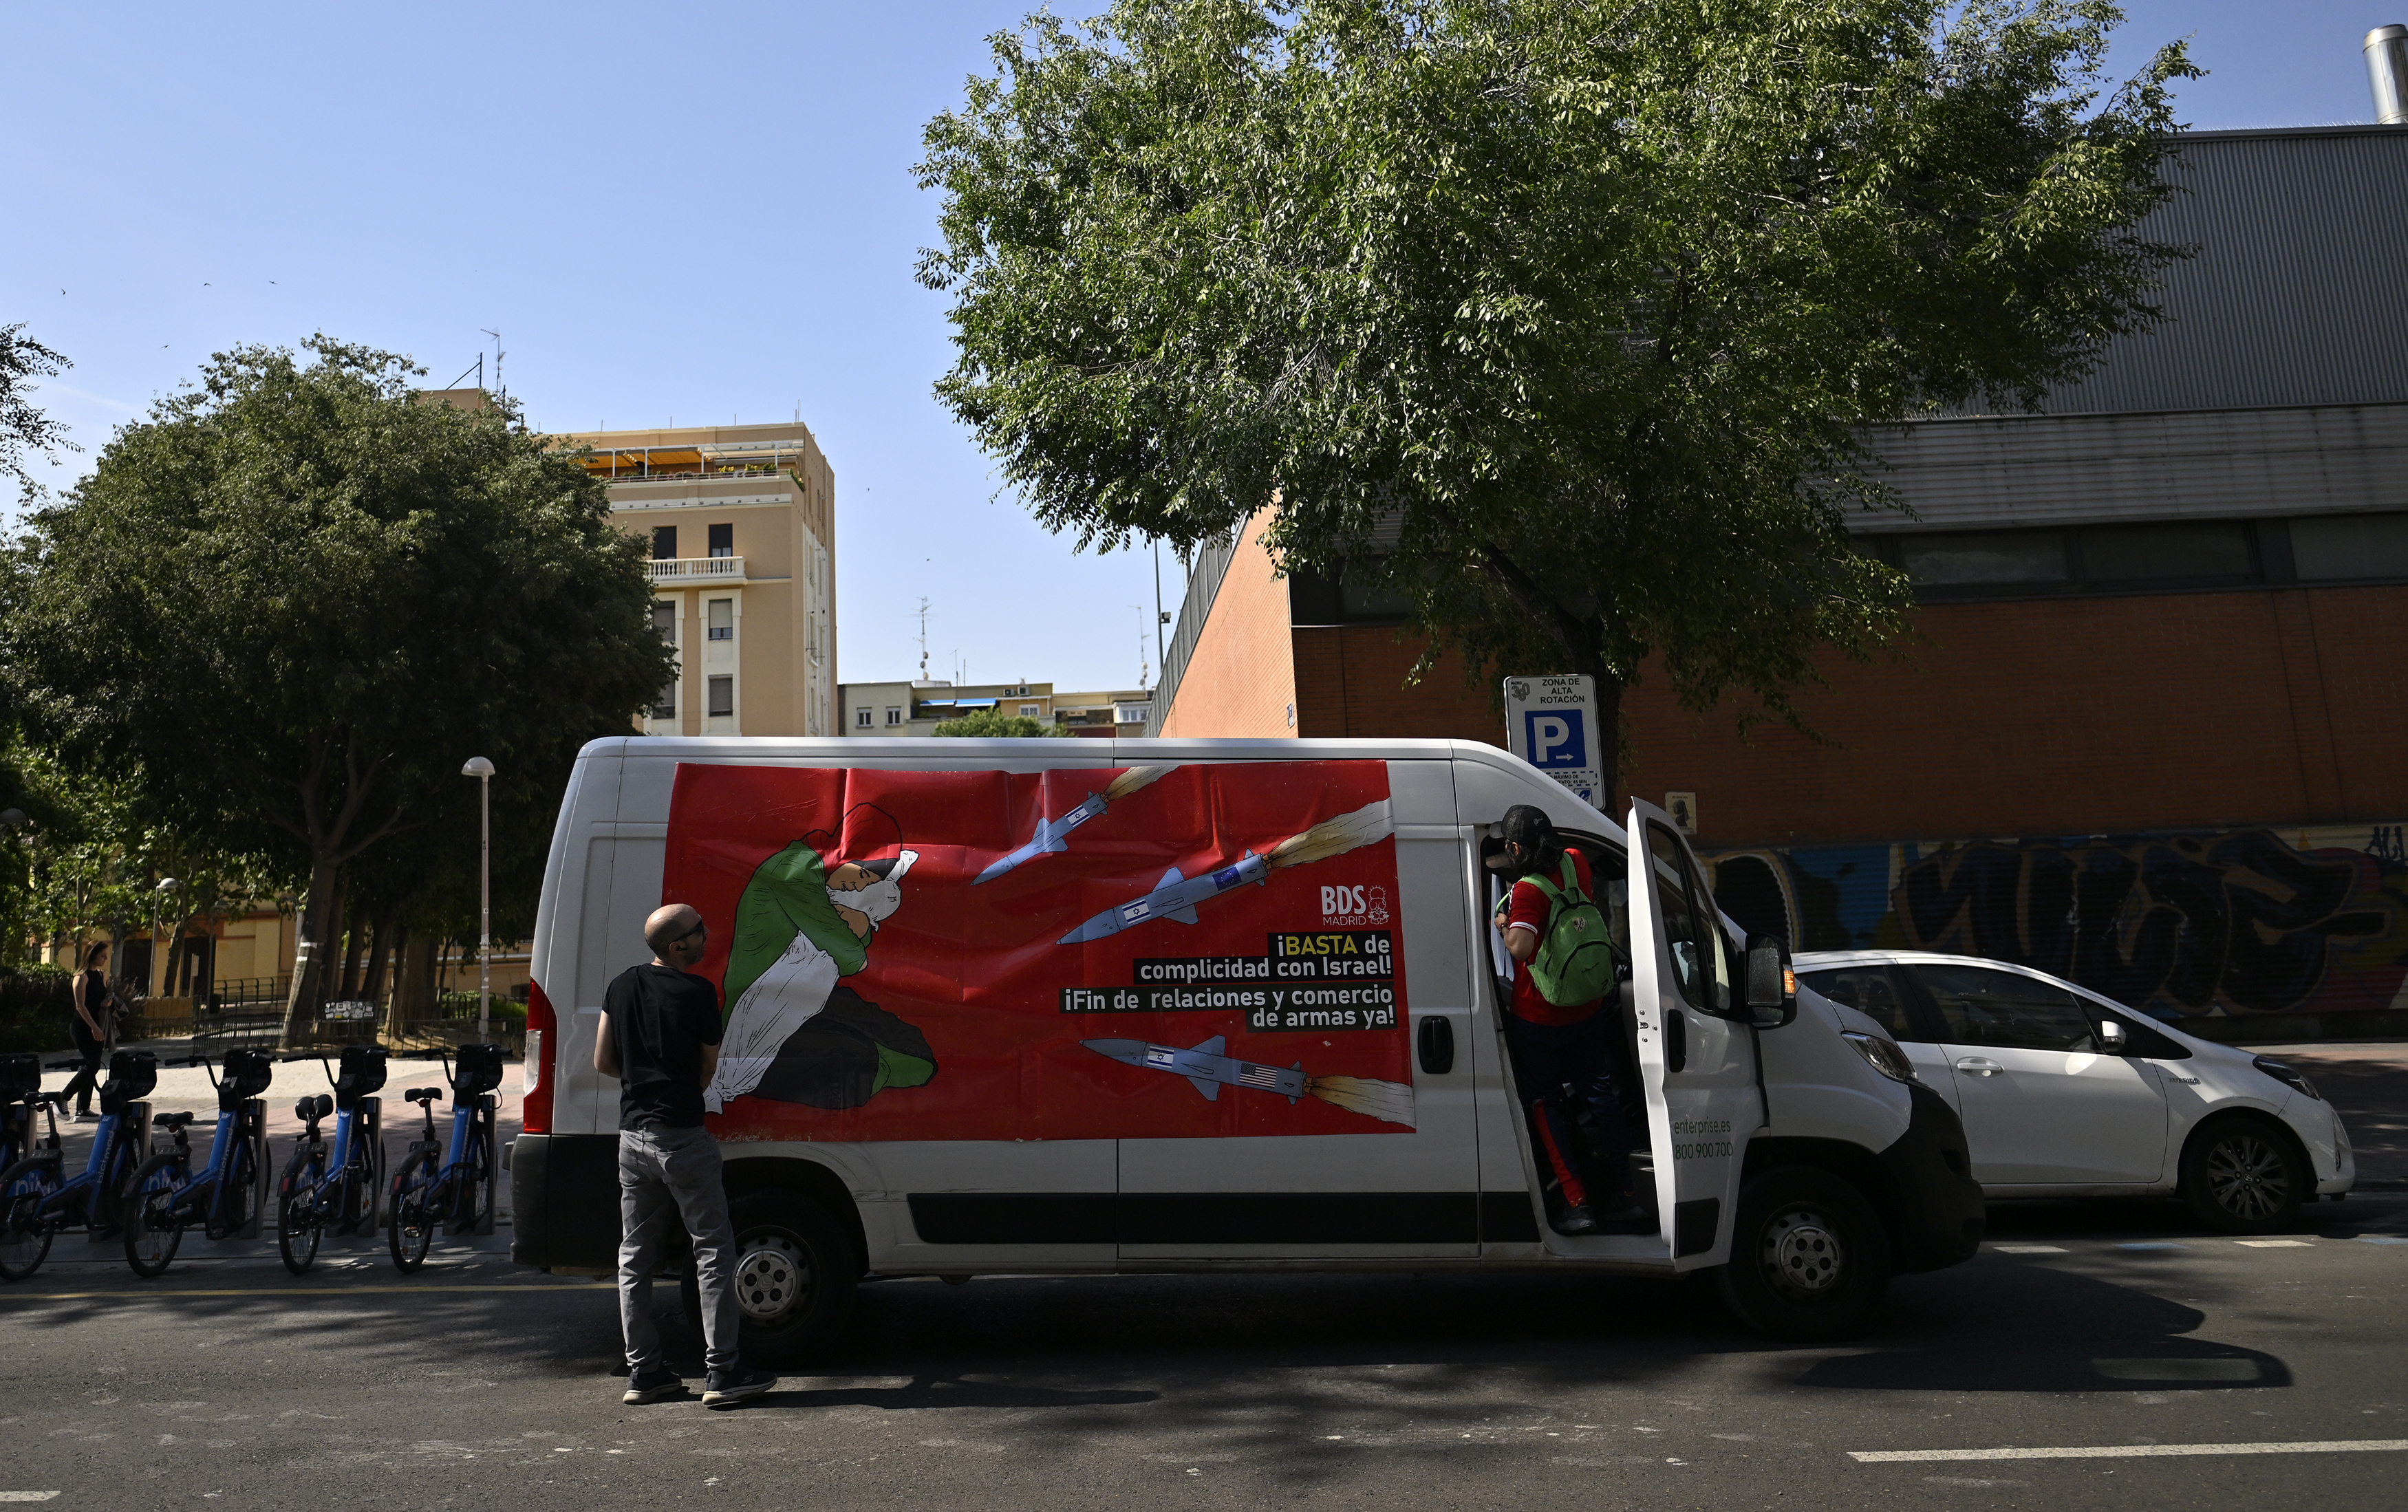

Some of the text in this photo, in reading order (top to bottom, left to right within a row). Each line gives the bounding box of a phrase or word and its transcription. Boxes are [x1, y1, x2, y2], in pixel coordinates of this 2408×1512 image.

[1540, 693, 1585, 704] ROTACIÓN
[1533, 716, 1569, 762] P
[1321, 885, 1366, 915] BDS
[1323, 916, 1367, 926] MADRID
[1278, 934, 1390, 957] ¡BASTA de
[1140, 955, 1391, 984] complicidad con Israel!
[1065, 984, 1393, 1011] ¡Fin de relaciones y comercio
[1253, 1004, 1395, 1030] de armas ya!
[1674, 1116, 1731, 1138] enterprise.es
[96, 1130, 114, 1183] bicimad
[218, 1127, 233, 1180] bicimad
[1675, 1141, 1733, 1160] 800 900 700
